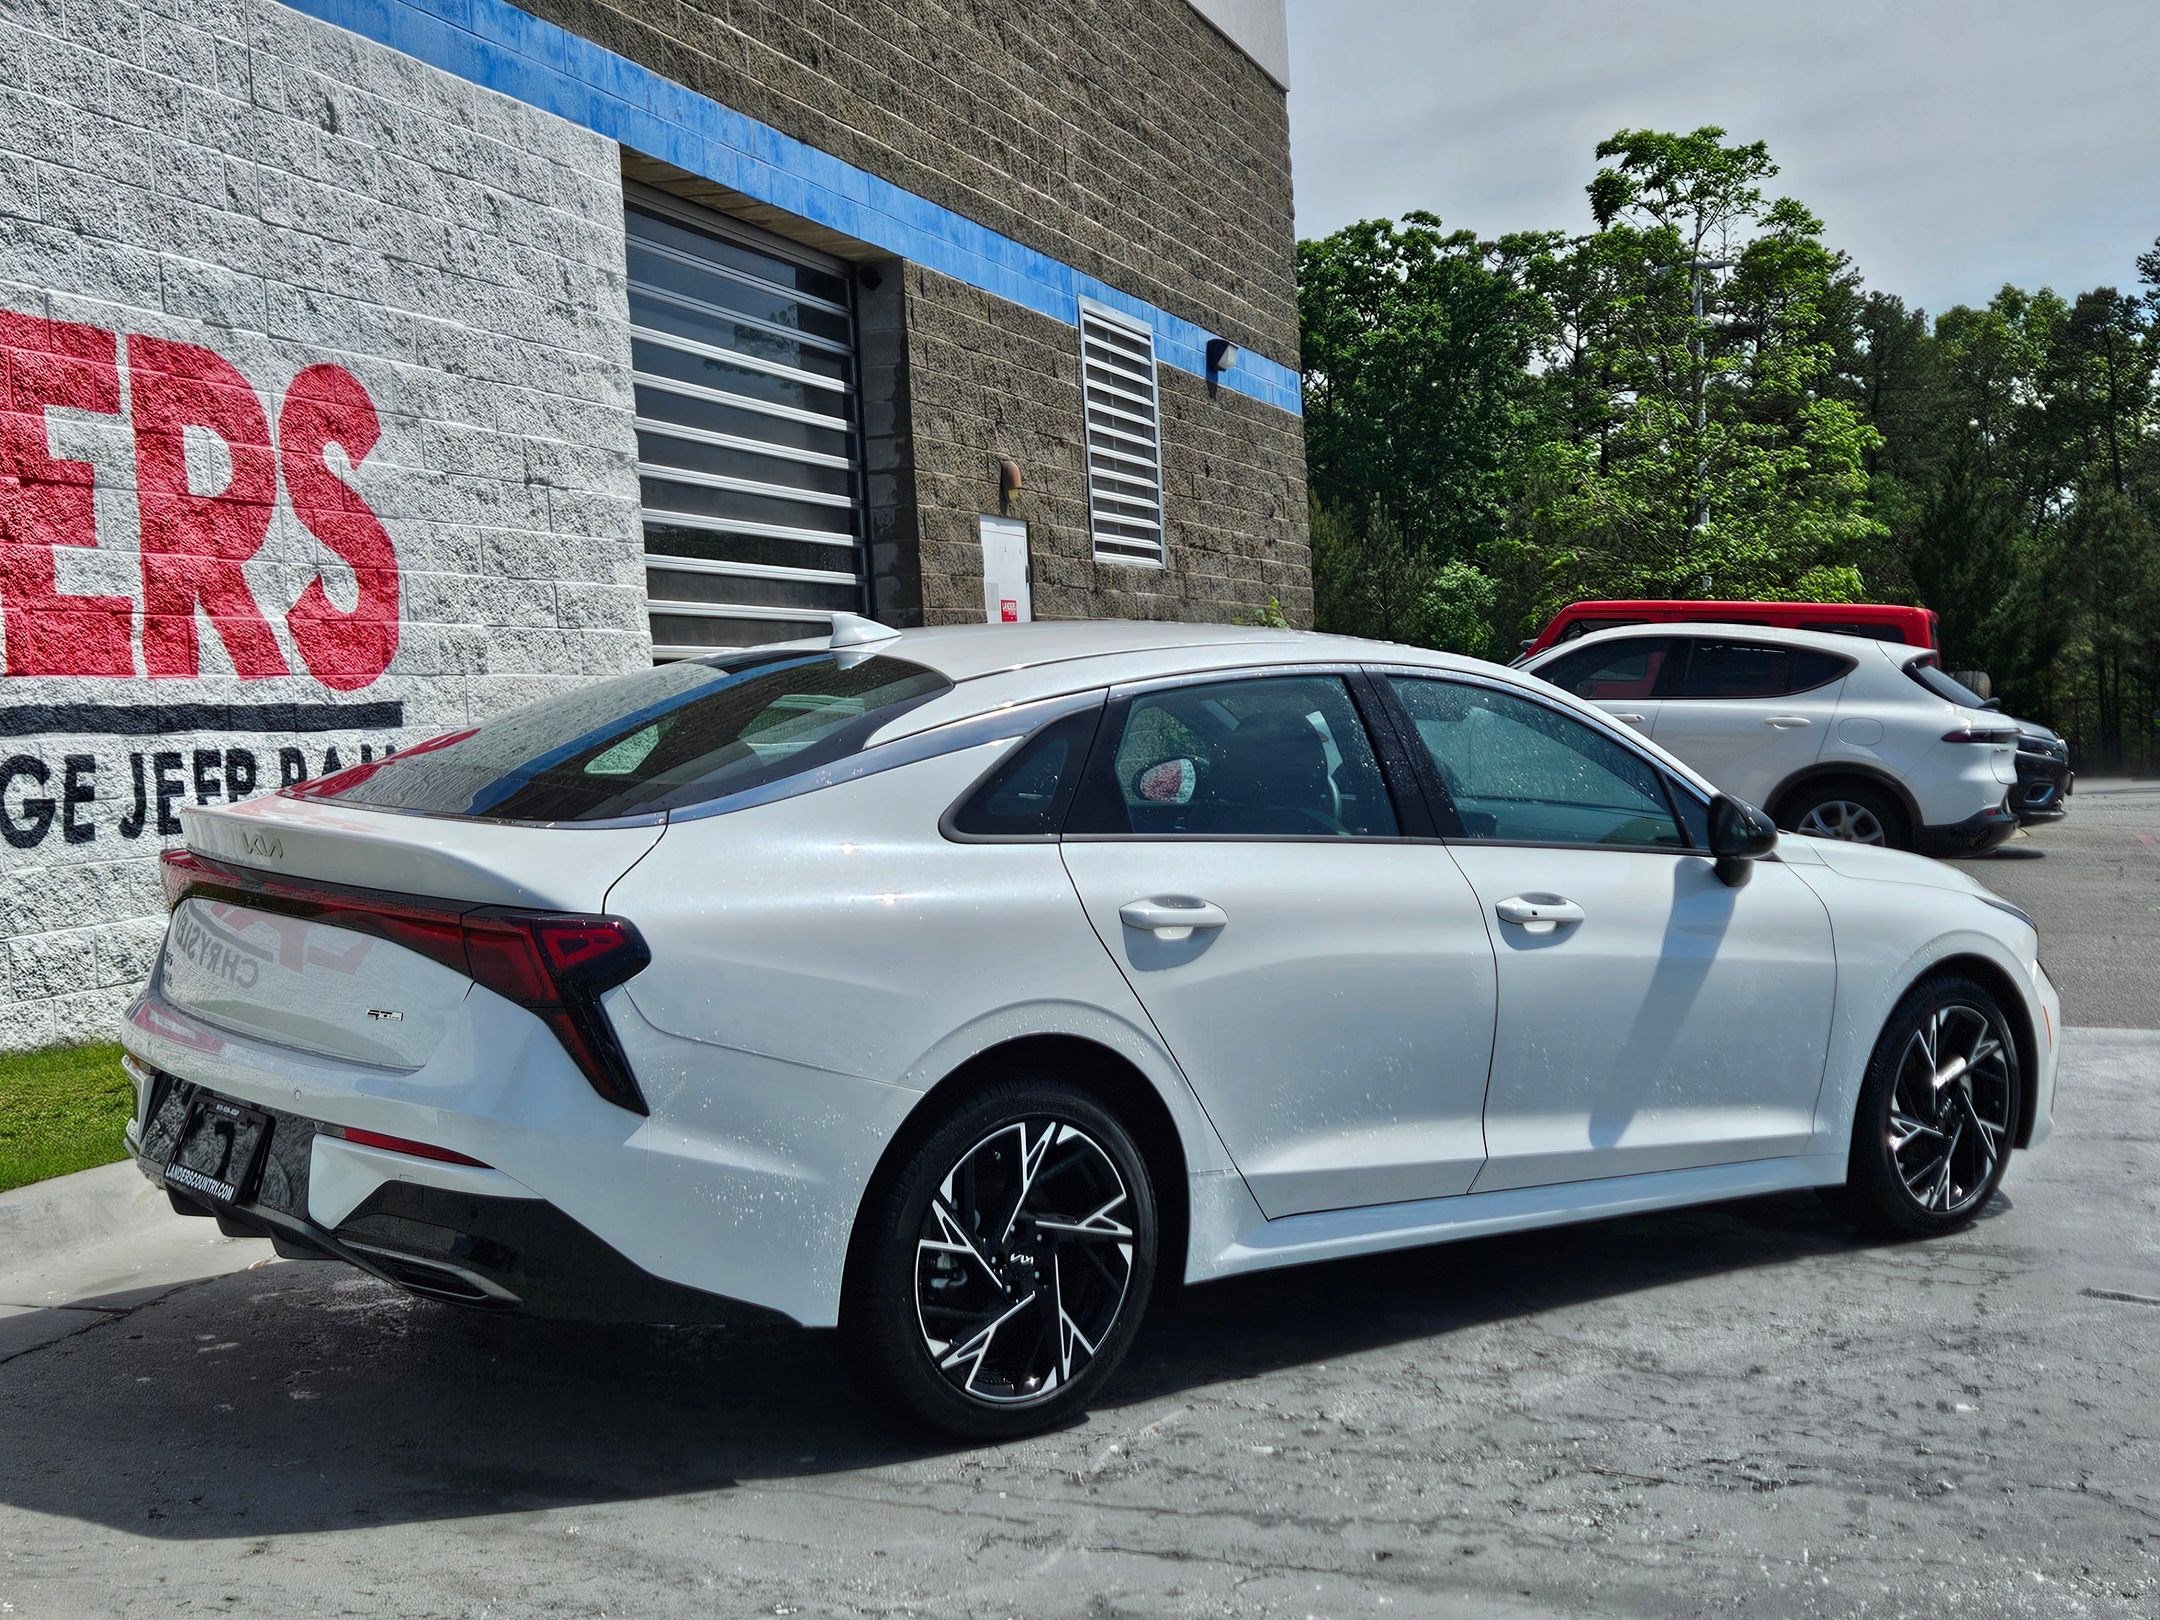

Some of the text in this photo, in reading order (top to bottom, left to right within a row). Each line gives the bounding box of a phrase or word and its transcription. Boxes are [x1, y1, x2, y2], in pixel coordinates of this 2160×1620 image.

[0, 309, 400, 691] ERS
[119, 747, 256, 840] JEEP
[243, 831, 284, 860] KIA
